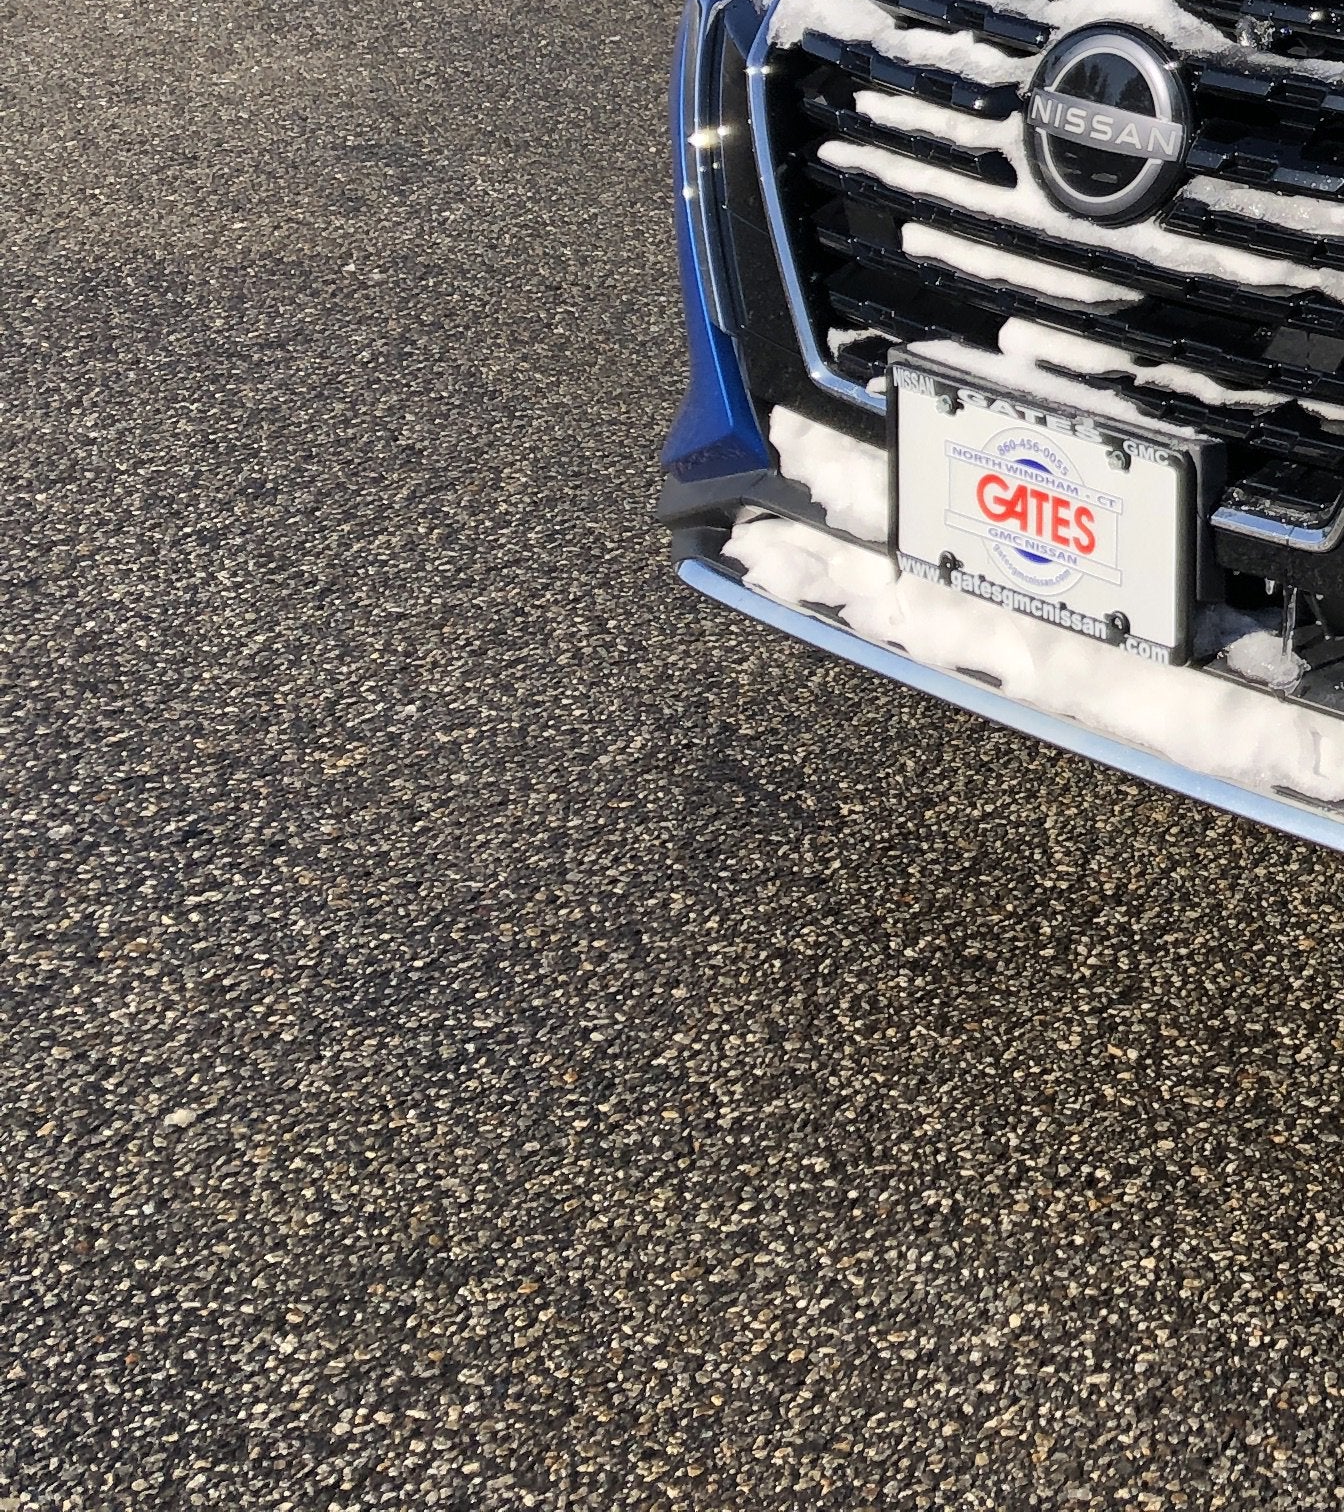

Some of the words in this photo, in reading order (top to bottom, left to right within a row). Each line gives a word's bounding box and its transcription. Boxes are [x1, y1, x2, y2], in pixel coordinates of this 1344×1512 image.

[1031, 94, 1177, 155] NISSAN
[893, 367, 935, 397] NISSAN
[957, 388, 1102, 442] GATES
[997, 438, 1069, 476] 860-456-0055
[1123, 440, 1170, 465] GMC
[952, 446, 1002, 469] NORTH
[1005, 463, 1080, 497] WINDHAM
[1097, 495, 1117, 509] CT
[976, 473, 1096, 555] GATES
[988, 527, 1023, 546] GMC
[1025, 540, 1078, 566] NISSAN
[993, 544, 1071, 587] gatesgmcnissan.com
[951, 569, 1107, 640] gatesgmcnissan
